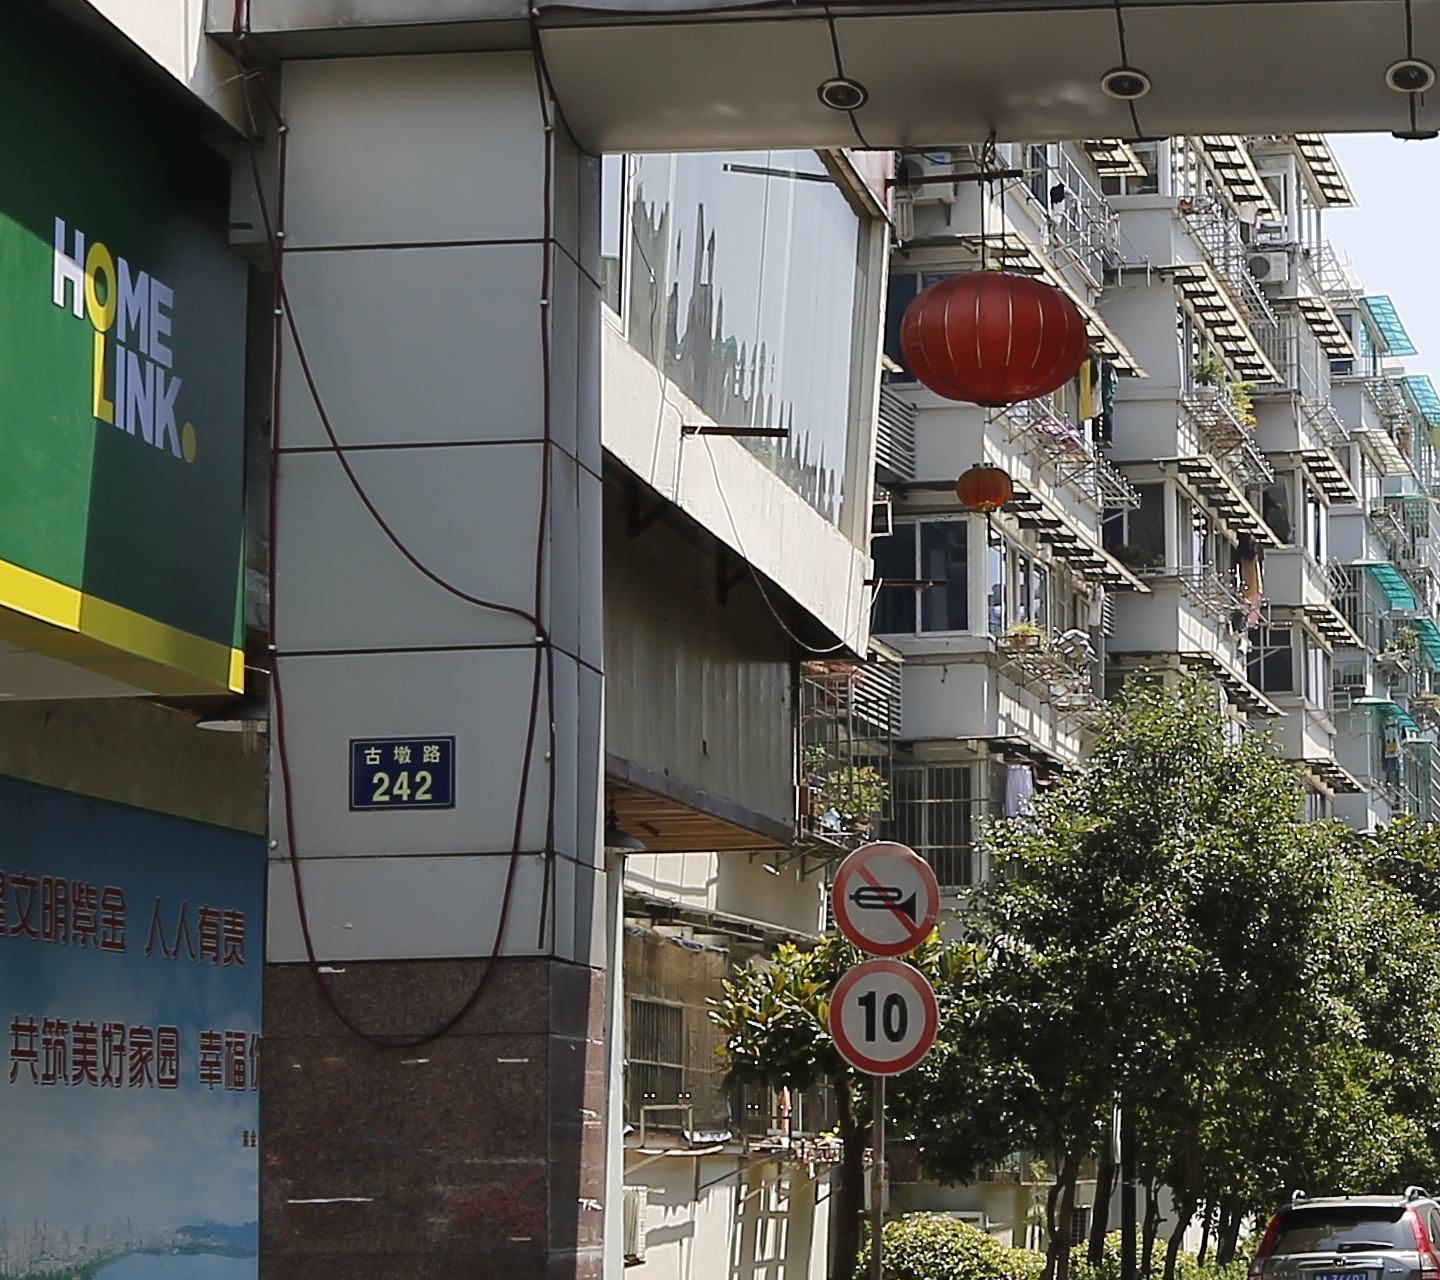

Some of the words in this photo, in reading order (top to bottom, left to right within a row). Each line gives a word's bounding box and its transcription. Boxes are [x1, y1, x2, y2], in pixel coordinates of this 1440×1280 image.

[53, 216, 173, 369] HOME
[364, 745, 441, 765] 古墩路
[372, 770, 432, 802] 242
[144, 895, 246, 968] 人人有责
[858, 990, 908, 1043] 10
[10, 1014, 180, 1089] 共筑美好家园
